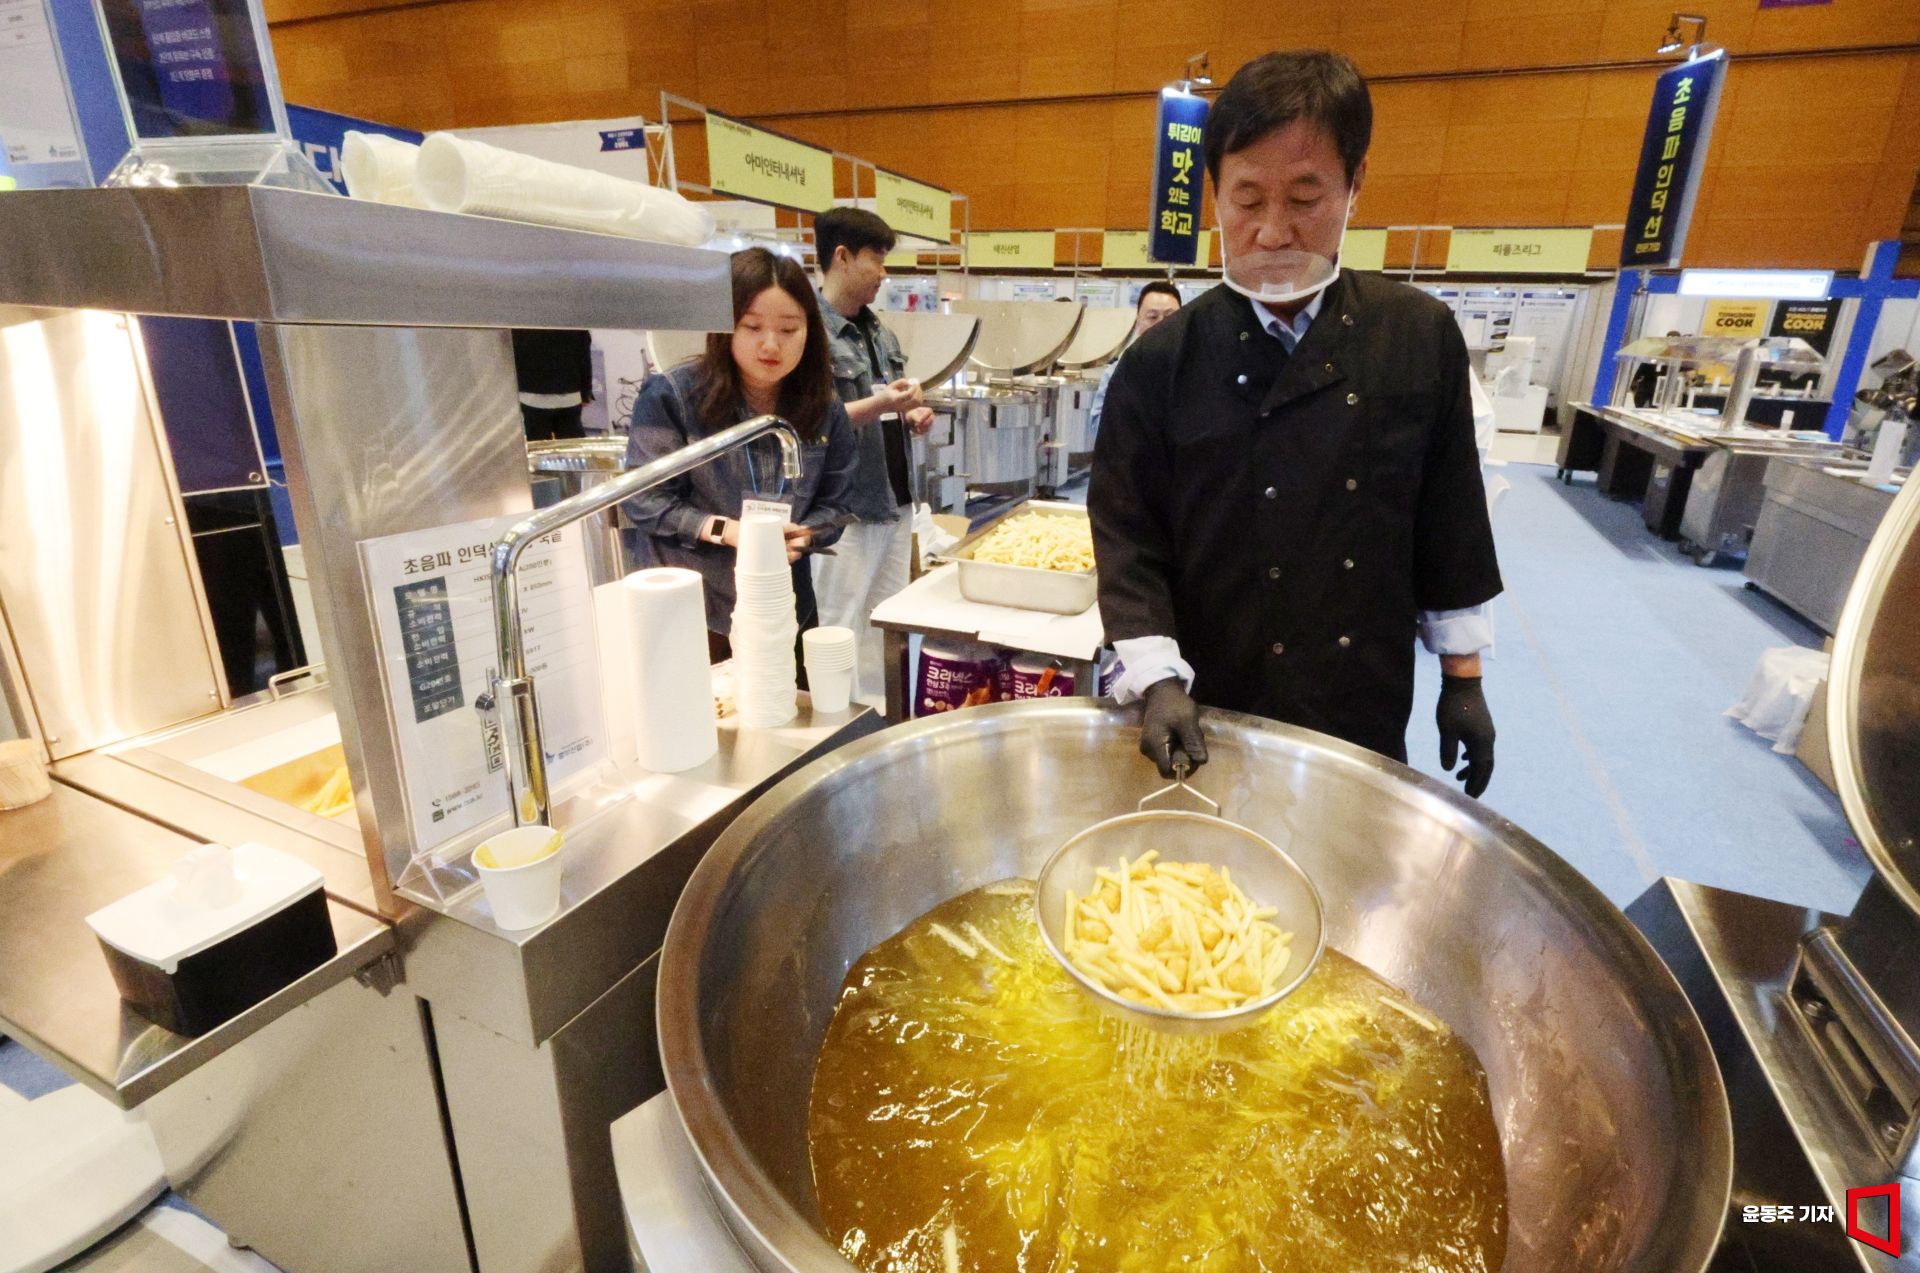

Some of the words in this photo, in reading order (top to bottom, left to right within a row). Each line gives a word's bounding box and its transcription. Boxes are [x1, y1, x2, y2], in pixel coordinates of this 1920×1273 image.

[1167, 123, 1201, 144] 튀김이
[745, 152, 806, 186] 아미인터내셔널
[1172, 148, 1193, 185] 맛
[1168, 187, 1189, 205] 있는
[1161, 210, 1193, 235] 학교
[1716, 318, 1754, 328] COOK
[1783, 319, 1825, 330] COOK
[403, 552, 452, 575] 초음파
